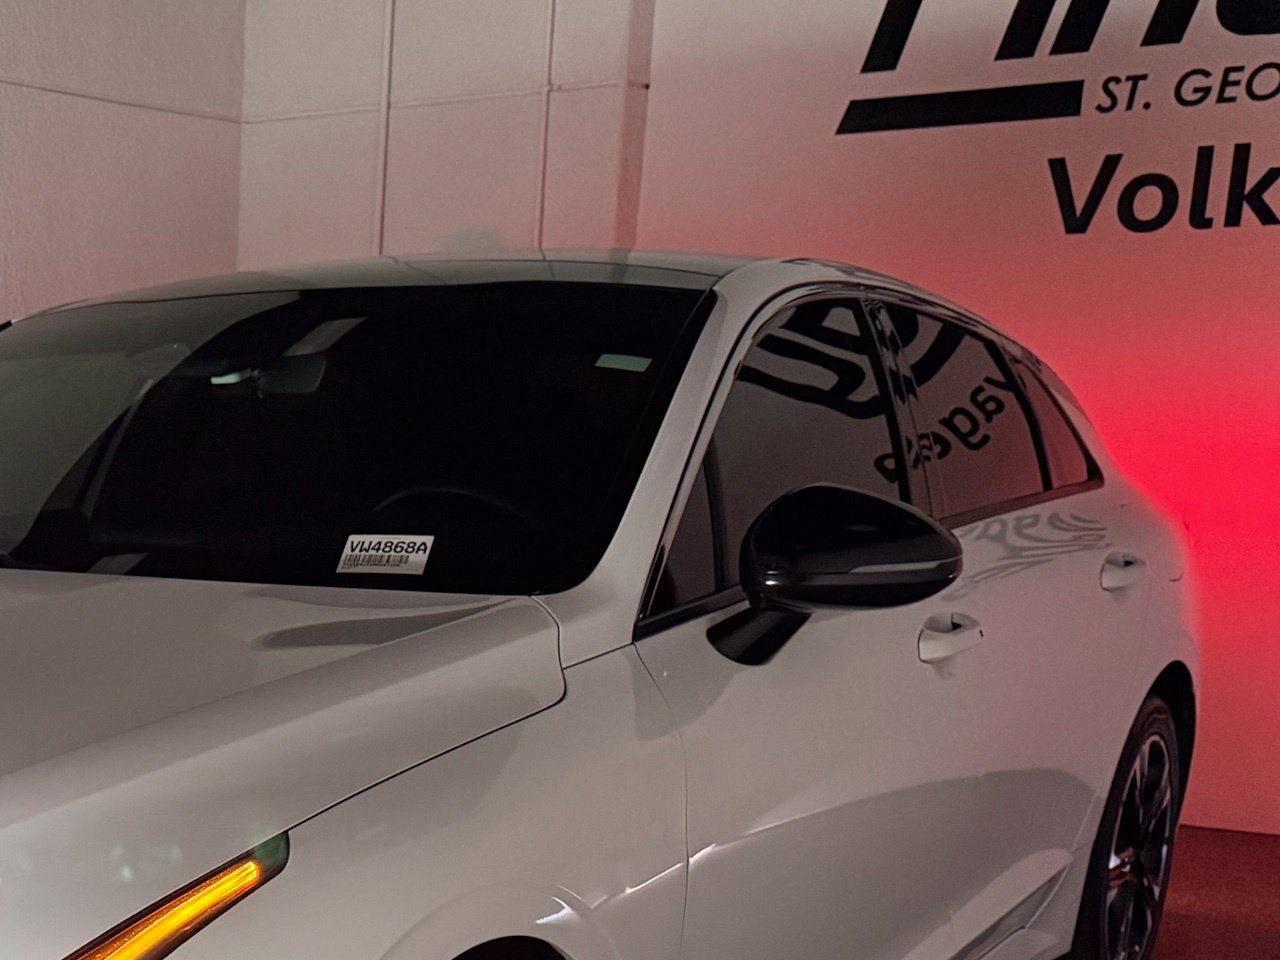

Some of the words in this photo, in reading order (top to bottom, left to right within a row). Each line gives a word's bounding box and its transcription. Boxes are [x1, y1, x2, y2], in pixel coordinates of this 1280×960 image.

[1095, 74, 1152, 114] ST.
[1173, 62, 1280, 107] GEO
[1047, 142, 1280, 235] Volk
[349, 540, 428, 554] VW4868A
